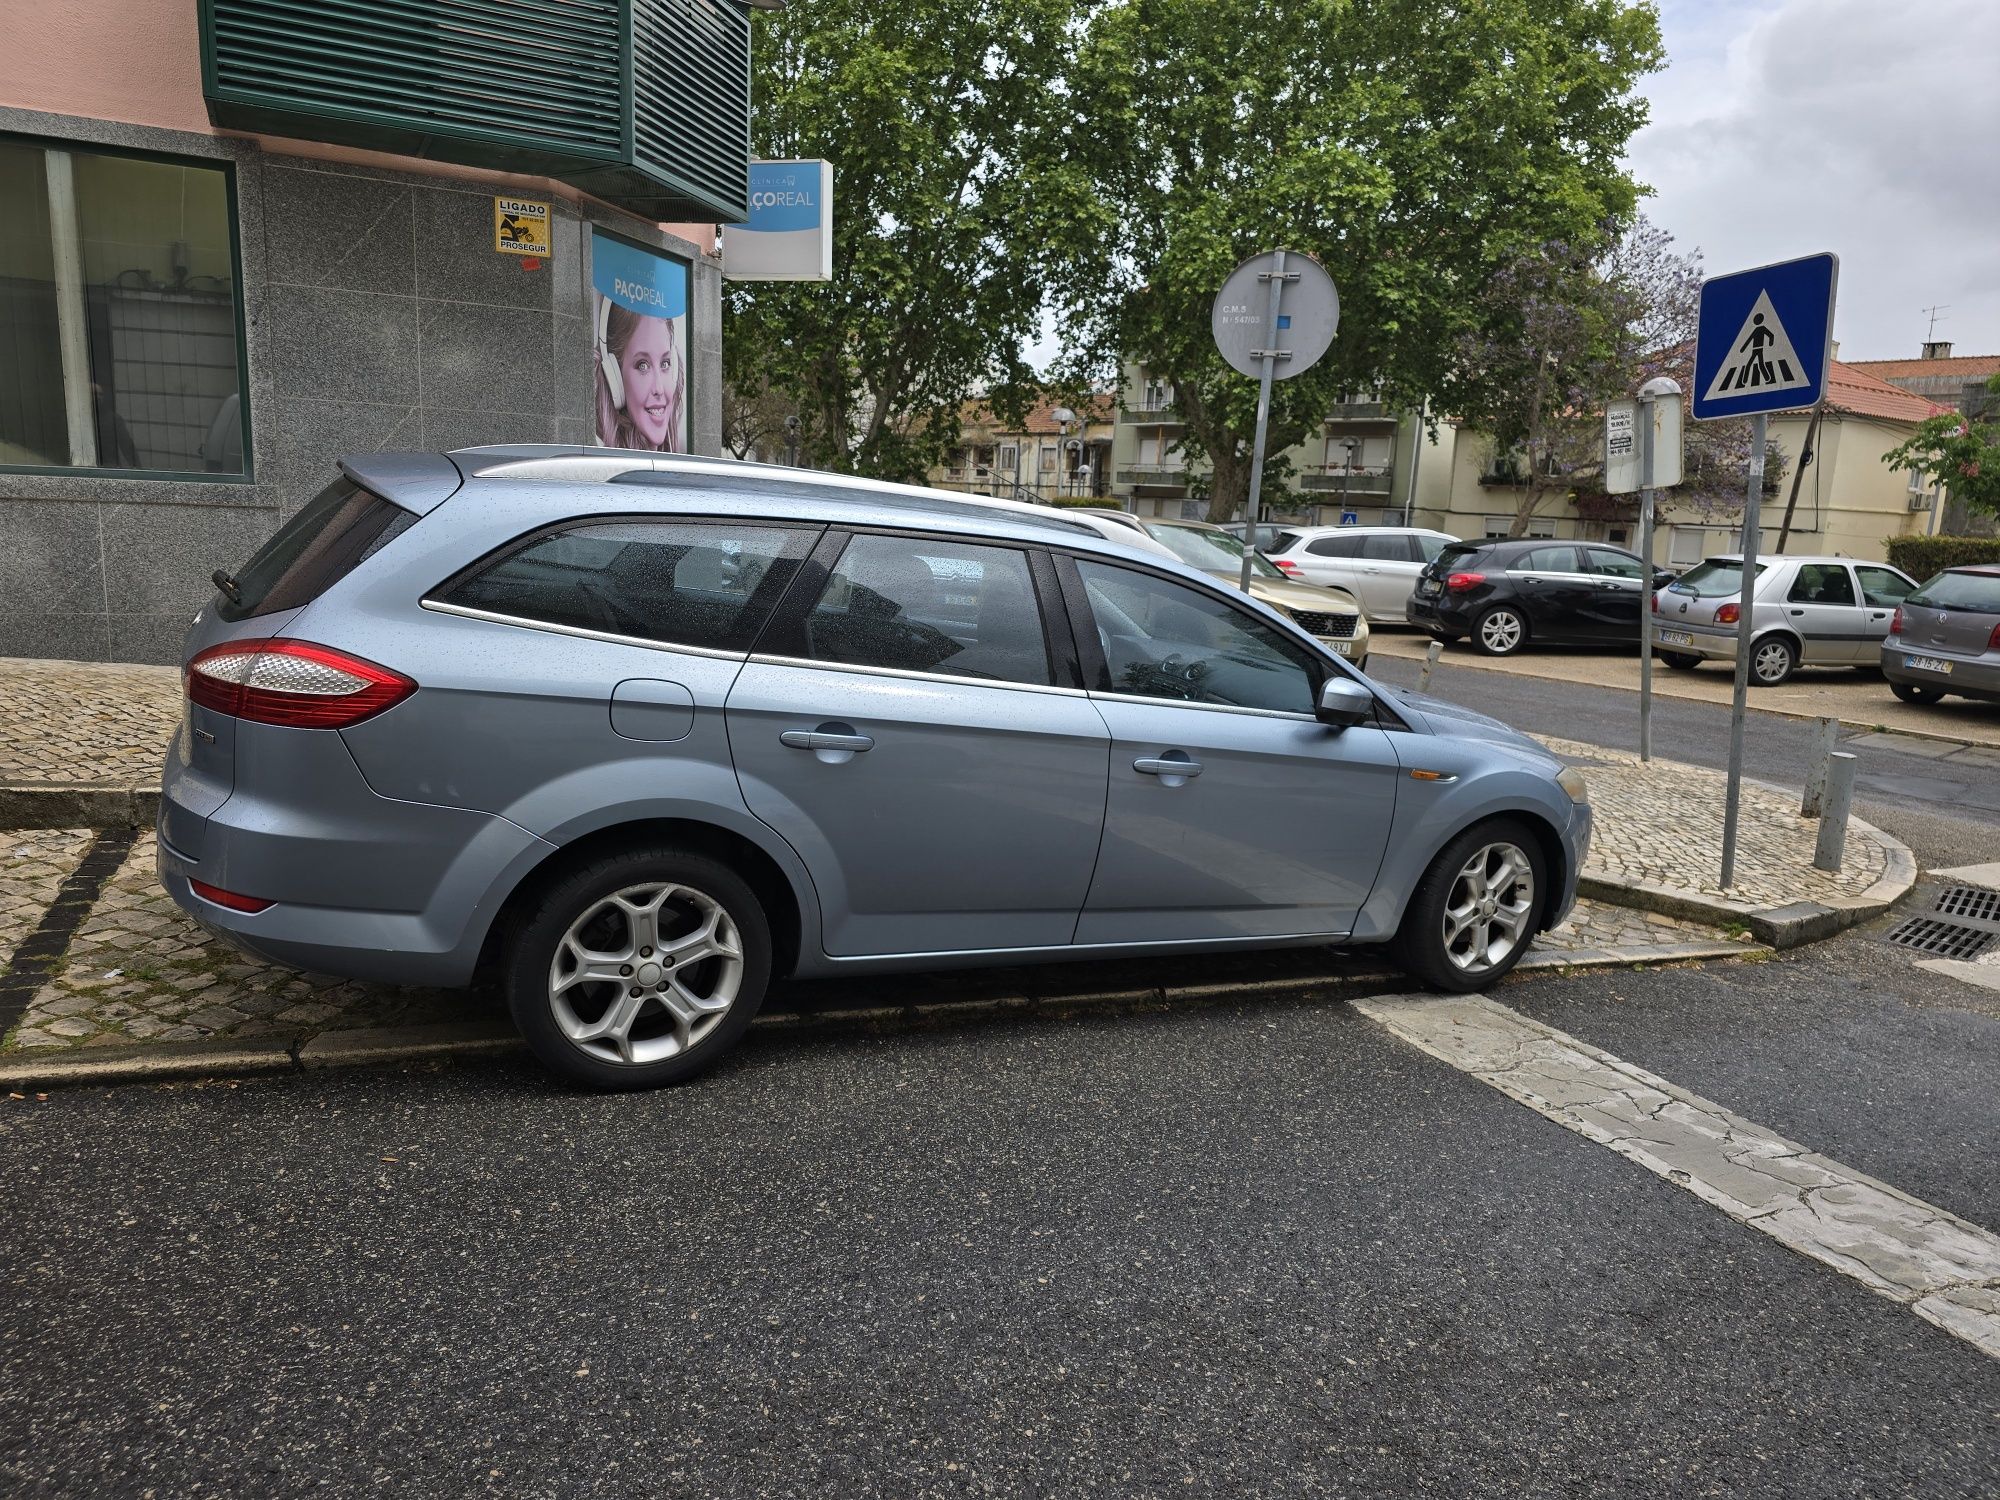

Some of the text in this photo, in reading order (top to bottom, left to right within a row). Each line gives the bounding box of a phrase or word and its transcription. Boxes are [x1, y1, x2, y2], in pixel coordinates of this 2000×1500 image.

[500, 201, 545, 214] LIGADO
[749, 191, 815, 211] ÇOREAL
[500, 241, 546, 253] PROSEGUR
[615, 278, 667, 308] PAÇOREAL
